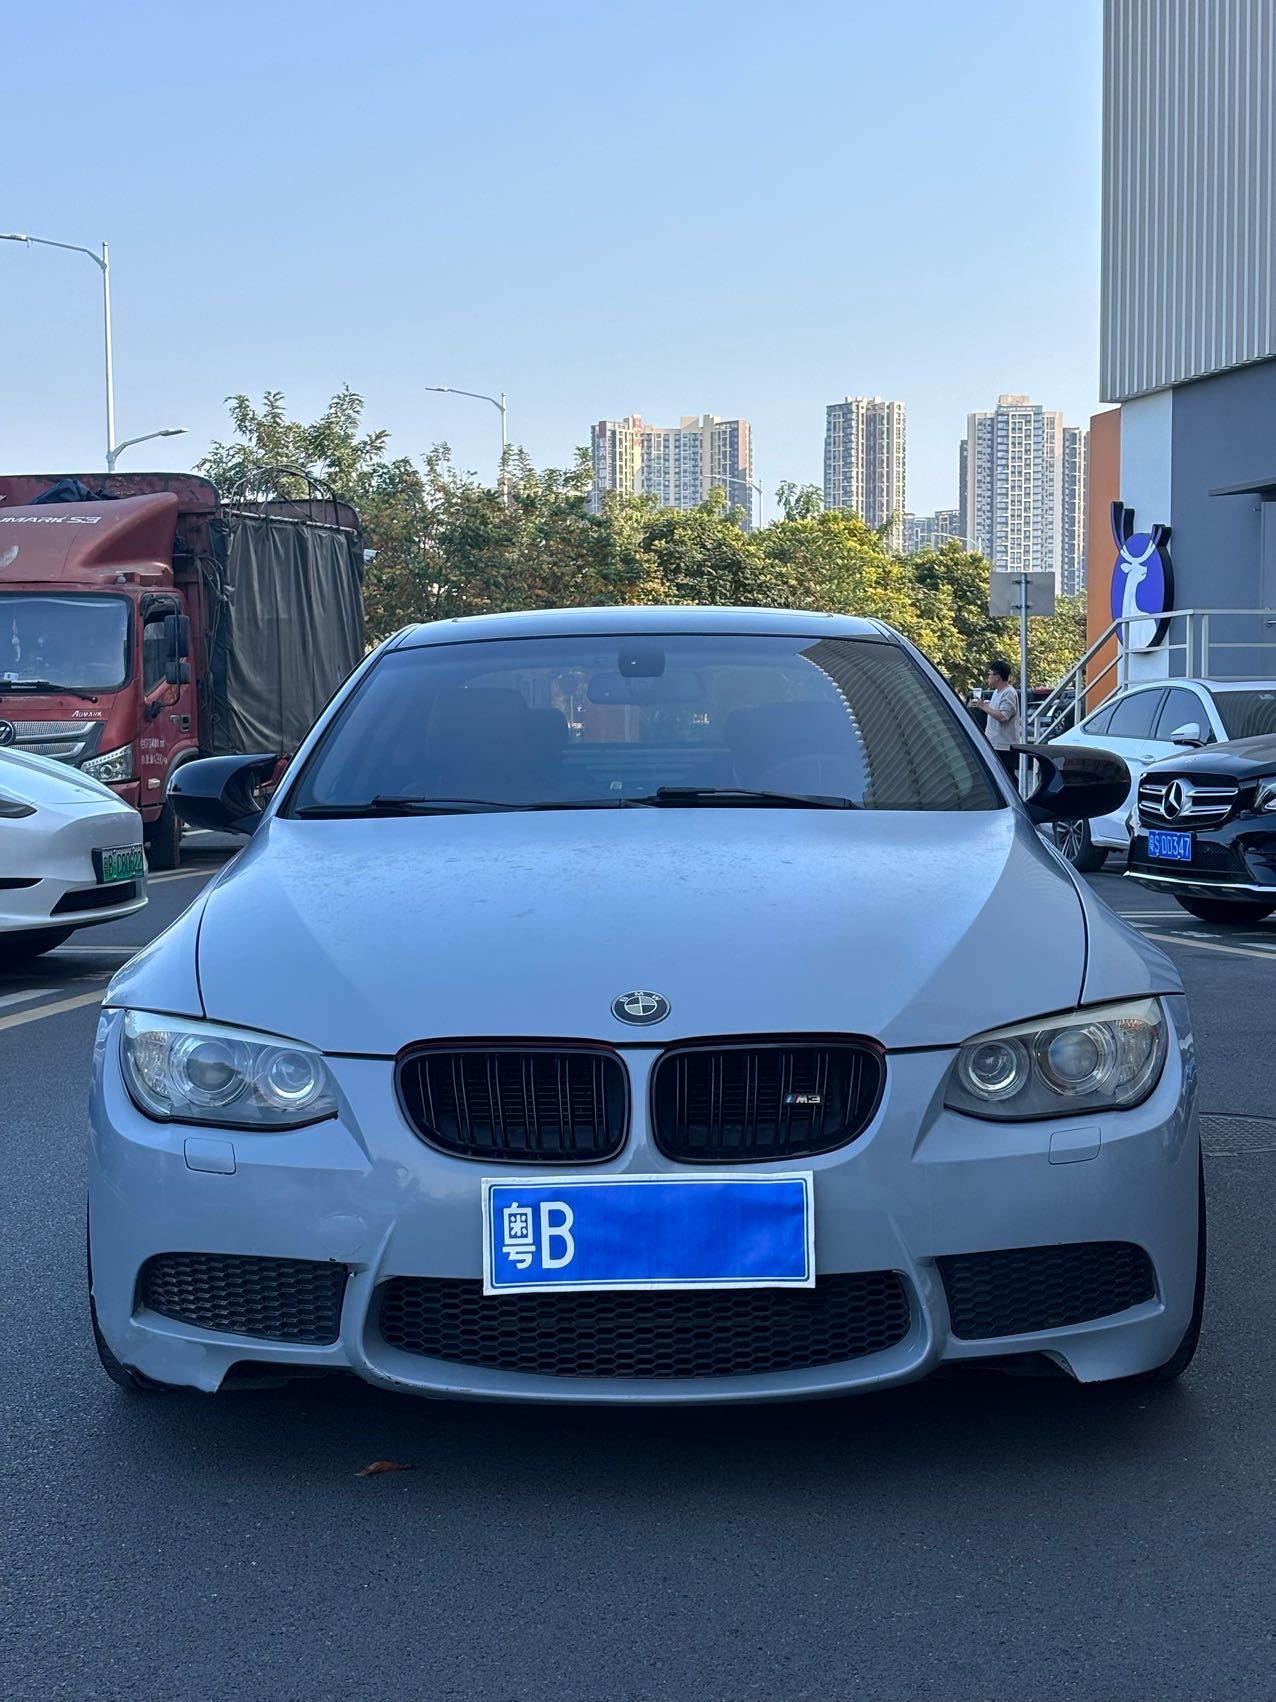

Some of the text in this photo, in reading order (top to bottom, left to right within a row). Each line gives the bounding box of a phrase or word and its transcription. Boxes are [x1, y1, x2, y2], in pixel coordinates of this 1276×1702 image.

[66, 516, 102, 524] S3
[619, 991, 662, 1002] BMW
[502, 1201, 575, 1269] 粤B
